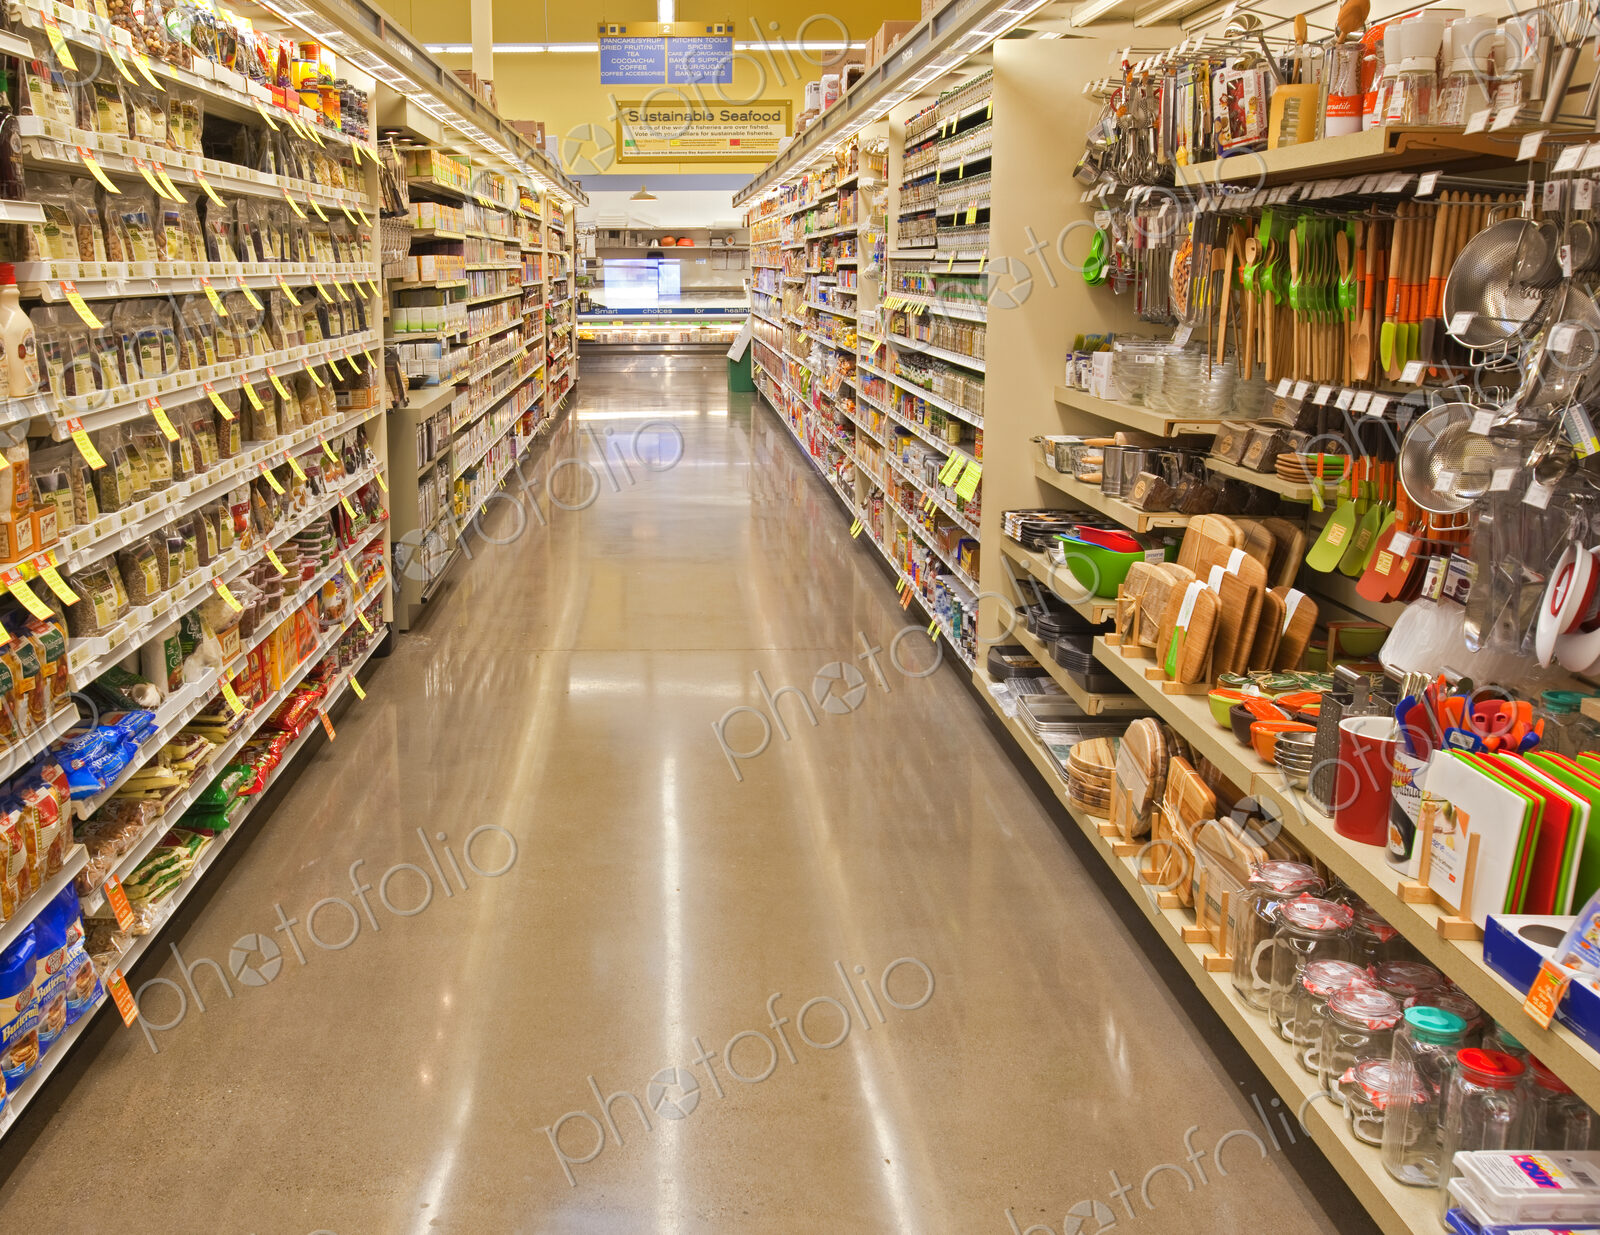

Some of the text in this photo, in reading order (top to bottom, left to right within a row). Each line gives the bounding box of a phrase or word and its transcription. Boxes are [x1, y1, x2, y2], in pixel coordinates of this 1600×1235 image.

[663, 25, 670, 33] 2
[628, 109, 781, 122] Sustainable Seafood
[594, 307, 618, 315] Smart
[642, 307, 673, 315] choices
